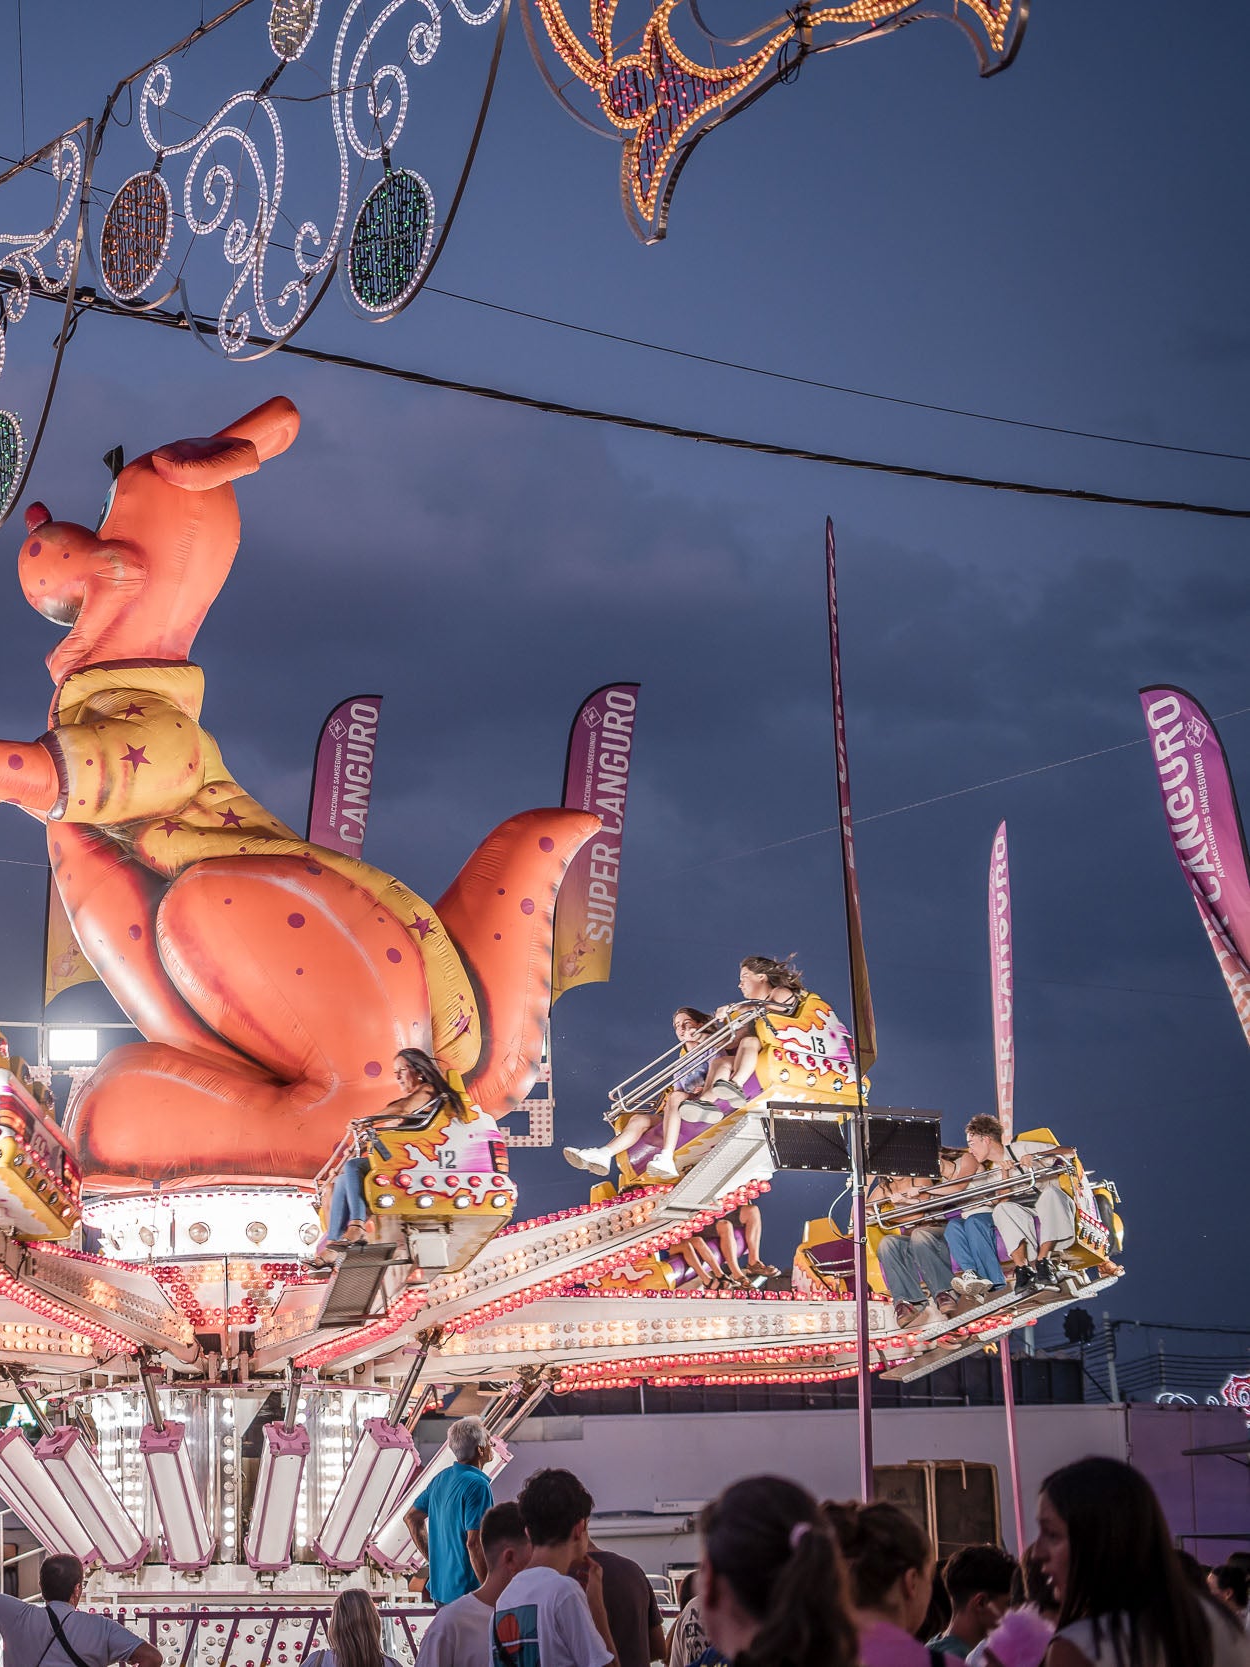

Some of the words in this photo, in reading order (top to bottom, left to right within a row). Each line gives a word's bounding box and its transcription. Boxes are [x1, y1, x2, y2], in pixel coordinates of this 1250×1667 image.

[333, 743, 342, 785] SANSEGUNDO
[339, 703, 379, 845] CANGURO
[586, 731, 597, 774] SANSEGUNDO
[595, 690, 637, 835] CANGURO
[1194, 752, 1210, 815] SANSEGUNDO
[329, 786, 340, 828] ATRACCIONES
[1147, 695, 1223, 904] CANGURO
[1203, 816, 1226, 878] ATRACCIONES
[586, 842, 621, 945] SUPER
[811, 1036, 826, 1055] 13
[437, 1150, 456, 1169] 12
